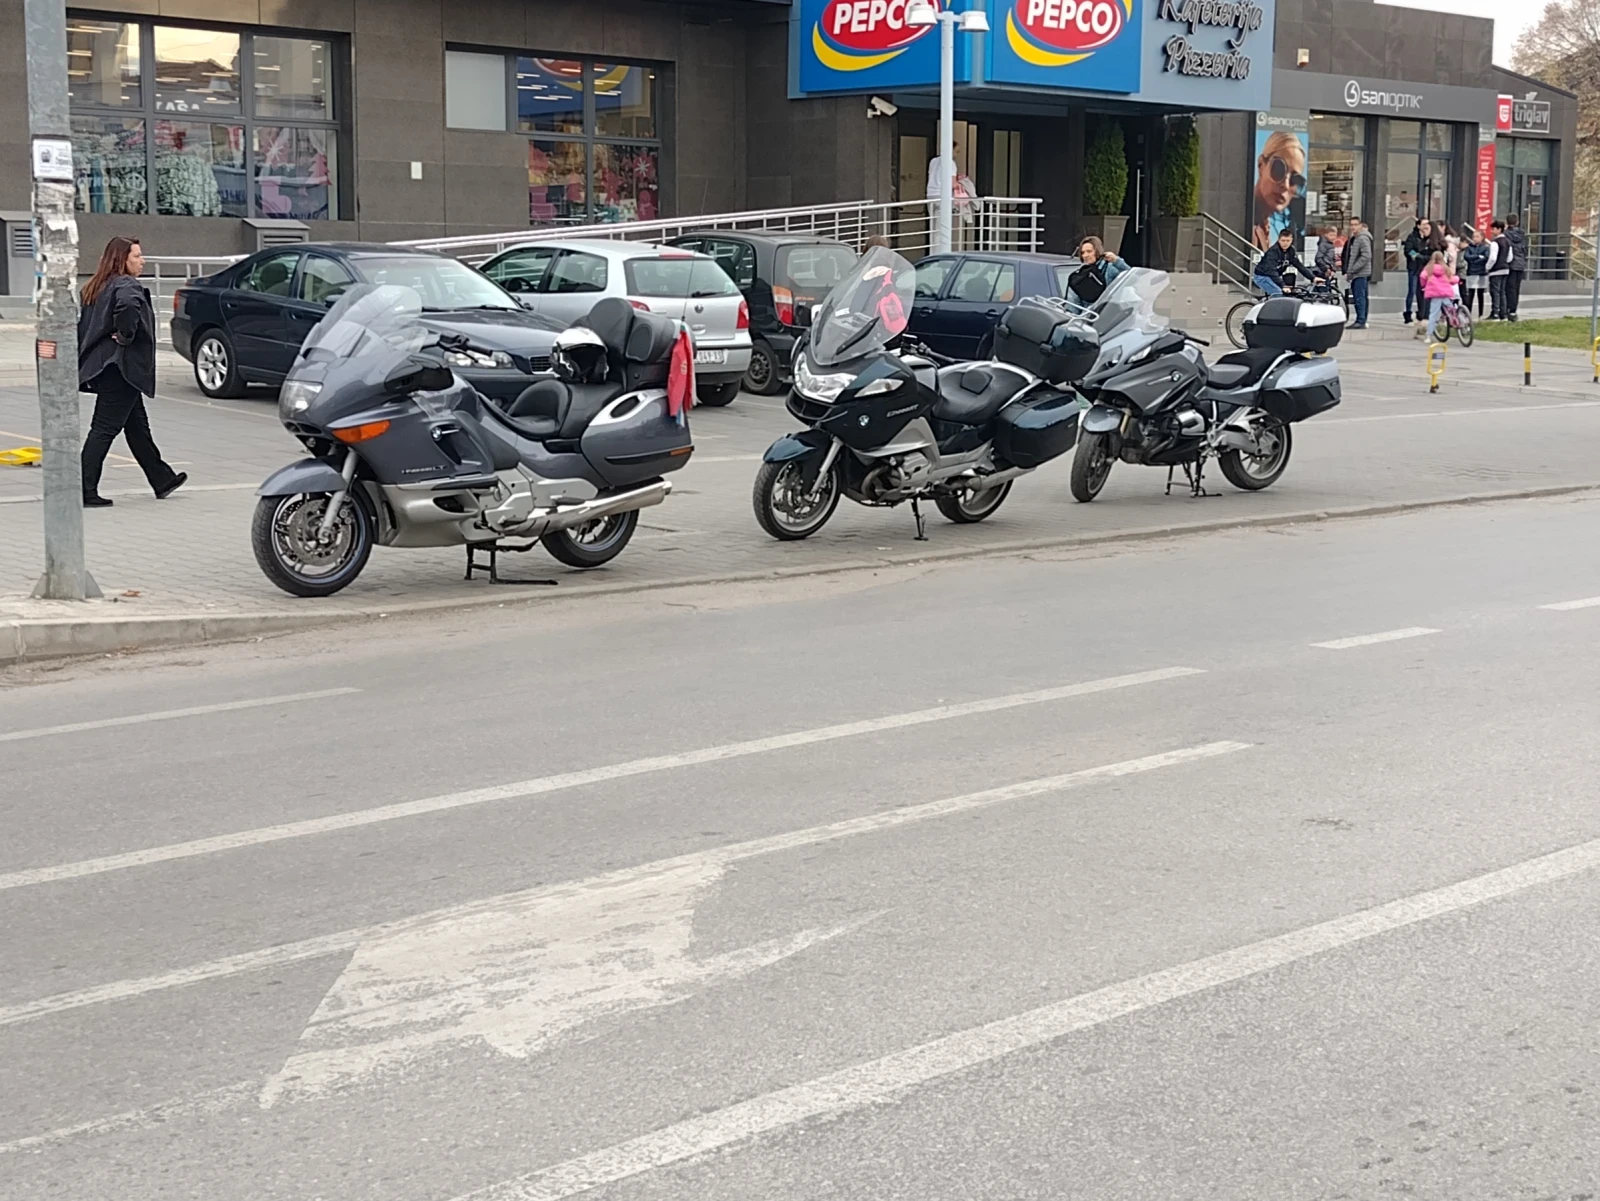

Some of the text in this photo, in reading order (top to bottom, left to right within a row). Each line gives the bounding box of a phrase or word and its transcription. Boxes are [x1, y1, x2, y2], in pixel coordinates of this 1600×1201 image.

[1026, 0, 1113, 35] PEPCO
[1159, 0, 1263, 48] Kafeterija
[1165, 34, 1251, 79] Pizzeria
[1513, 104, 1549, 128] triglav
